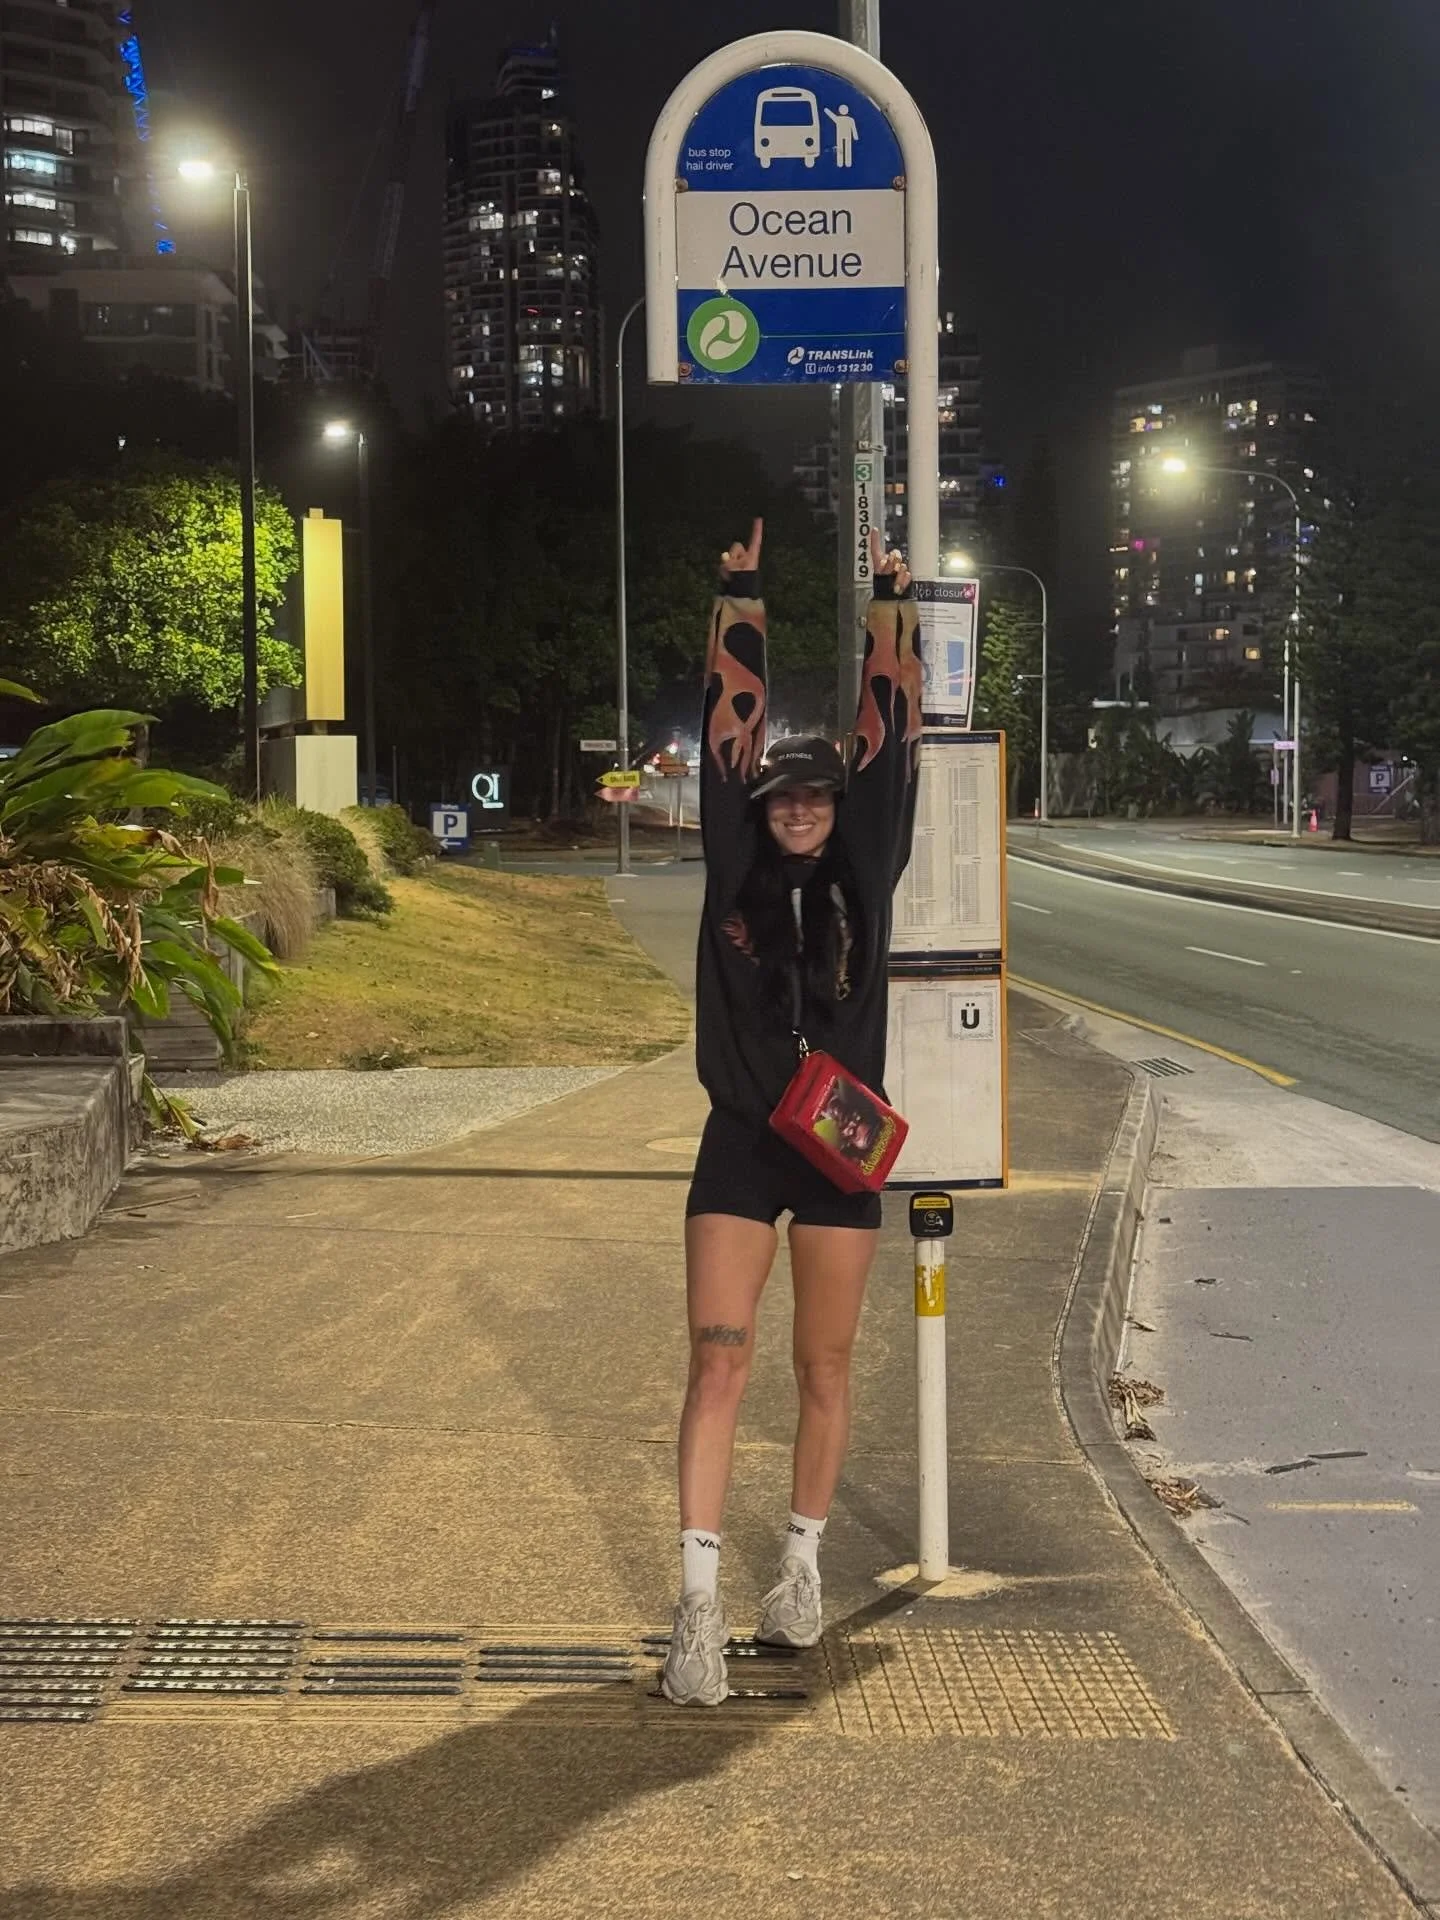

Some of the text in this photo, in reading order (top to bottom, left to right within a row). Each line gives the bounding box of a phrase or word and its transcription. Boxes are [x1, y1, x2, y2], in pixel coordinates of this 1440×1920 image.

[688, 147, 731, 159] bus stop
[686, 160, 734, 171] hail driver
[729, 201, 852, 236] Ocean
[720, 245, 862, 279] Avenue
[807, 349, 874, 361] TRANSLink
[818, 363, 835, 373] info
[1375, 773, 1385, 785] P
[443, 814, 458, 835] P
[960, 1002, 980, 1030] Ü
